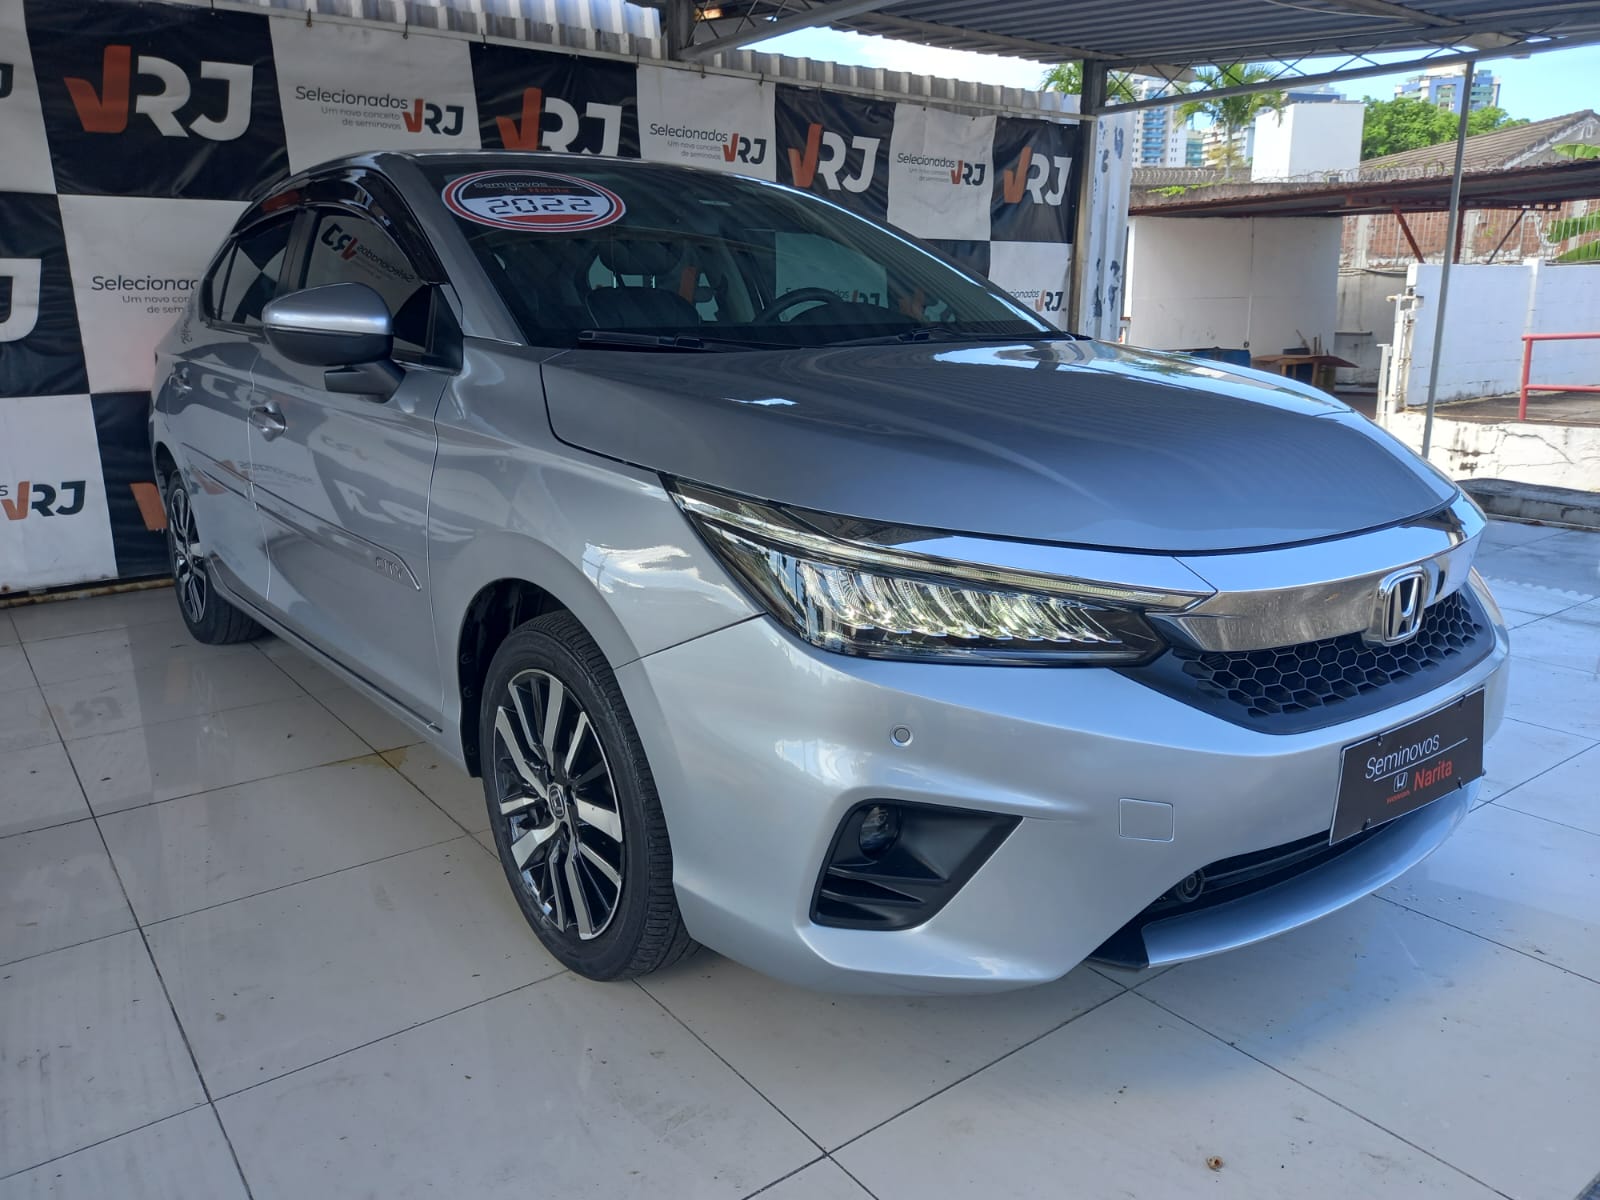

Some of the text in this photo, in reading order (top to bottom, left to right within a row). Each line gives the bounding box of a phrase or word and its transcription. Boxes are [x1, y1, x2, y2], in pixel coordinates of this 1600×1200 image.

[64, 44, 254, 141] VRJ
[295, 86, 464, 136] Selecionados VRJ
[321, 106, 400, 120] Um novo conceito
[342, 118, 401, 130] de seminovos
[649, 123, 767, 165] Selecionados VRJ
[787, 122, 881, 193] VRJ
[897, 152, 986, 186] Selecionados VRJ
[1003, 145, 1073, 206] VRJ
[486, 197, 594, 215] 2022
[122, 295, 142, 304] Um
[144, 295, 170, 304] novo
[146, 305, 160, 314] de
[0, 480, 86, 520] VRJ
[1365, 734, 1440, 780] Seminovos
[1413, 759, 1453, 791] Narita
